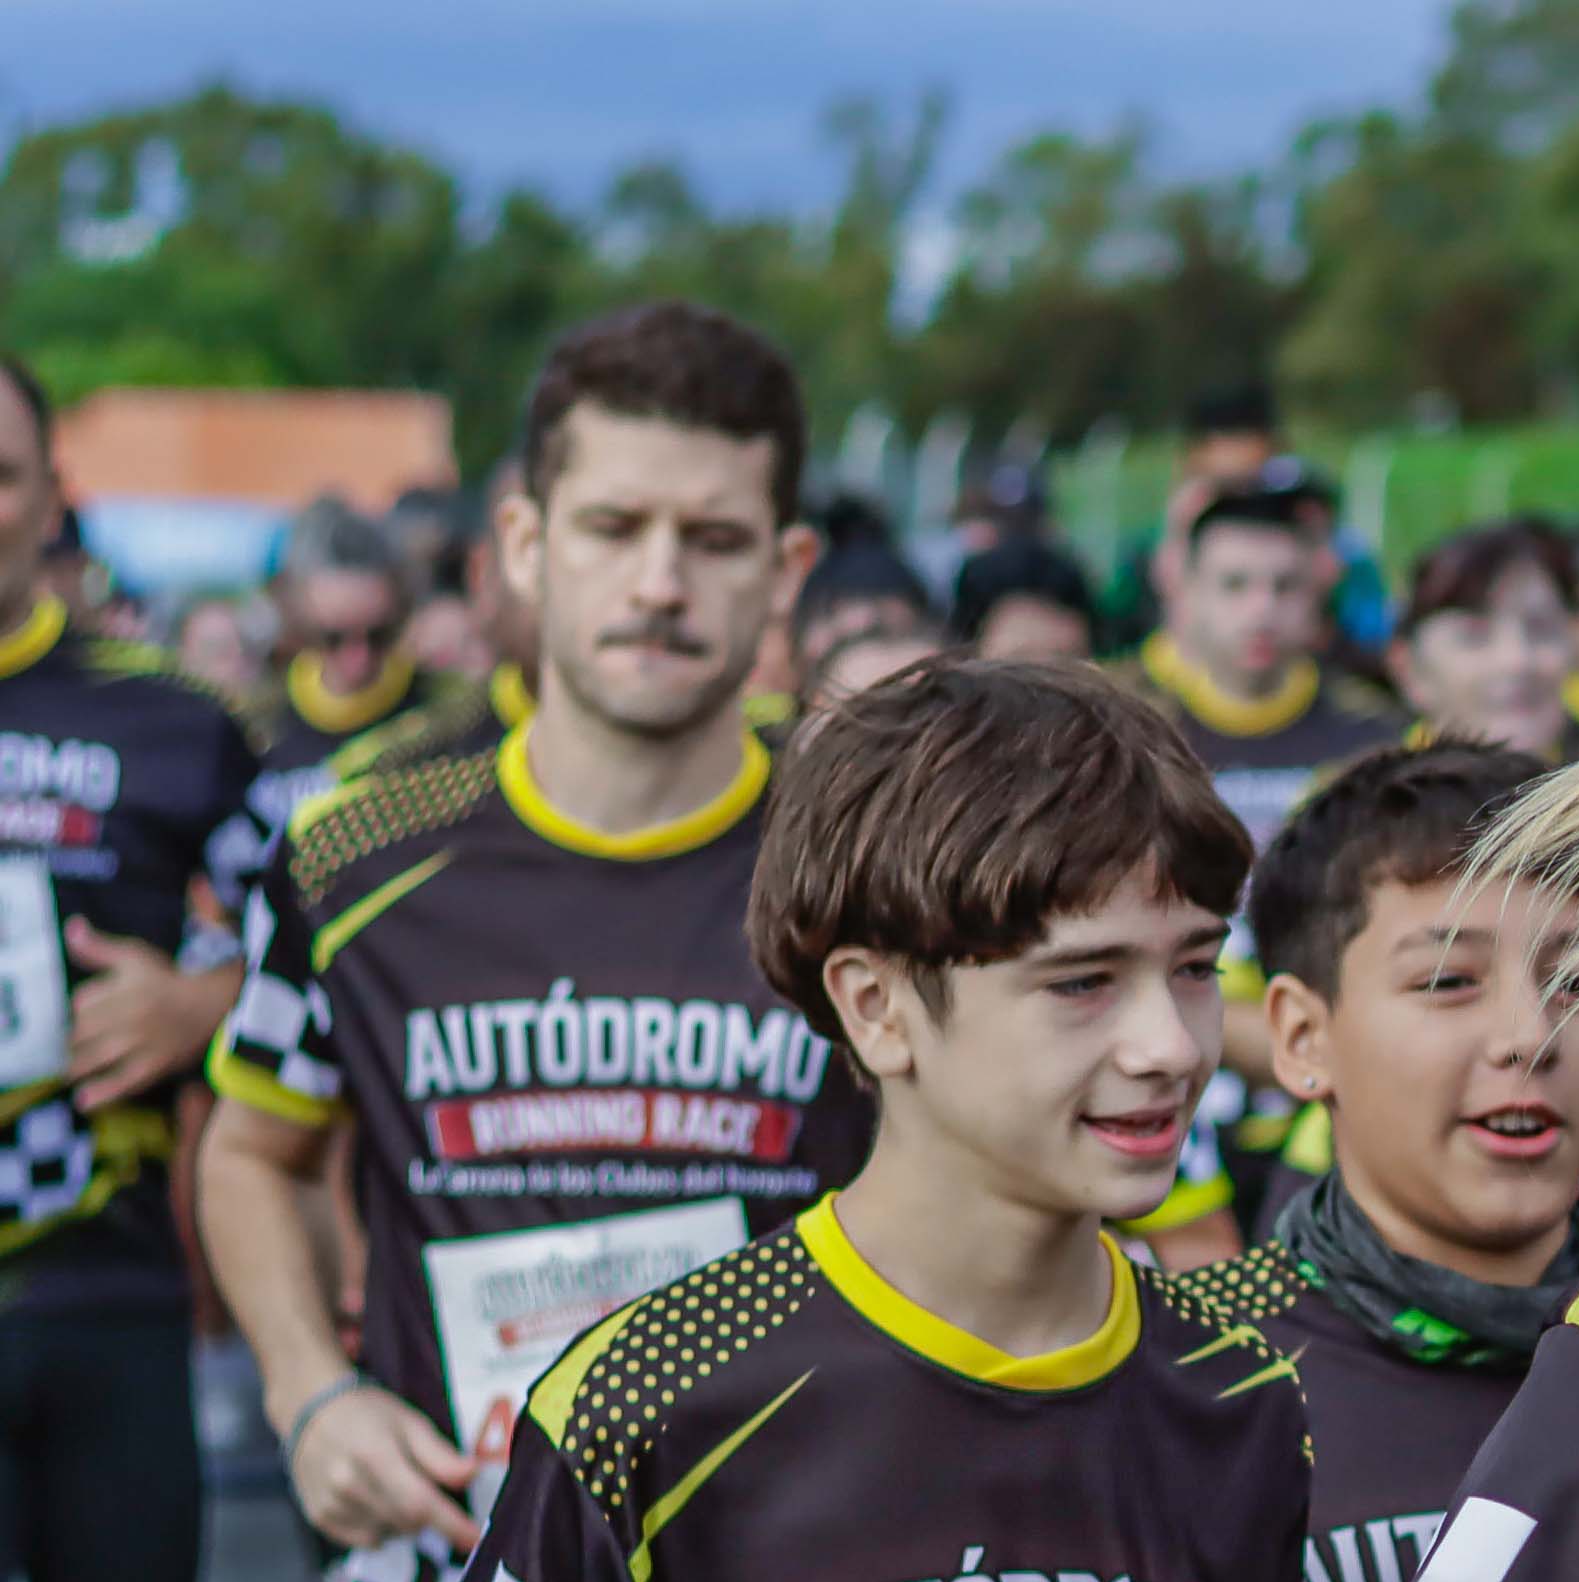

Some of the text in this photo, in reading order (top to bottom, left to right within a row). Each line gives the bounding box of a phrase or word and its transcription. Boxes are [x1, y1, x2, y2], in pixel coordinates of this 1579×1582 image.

[405, 976, 831, 1102] AUTÓDROMO
[470, 1092, 760, 1154] RUNNING RACE
